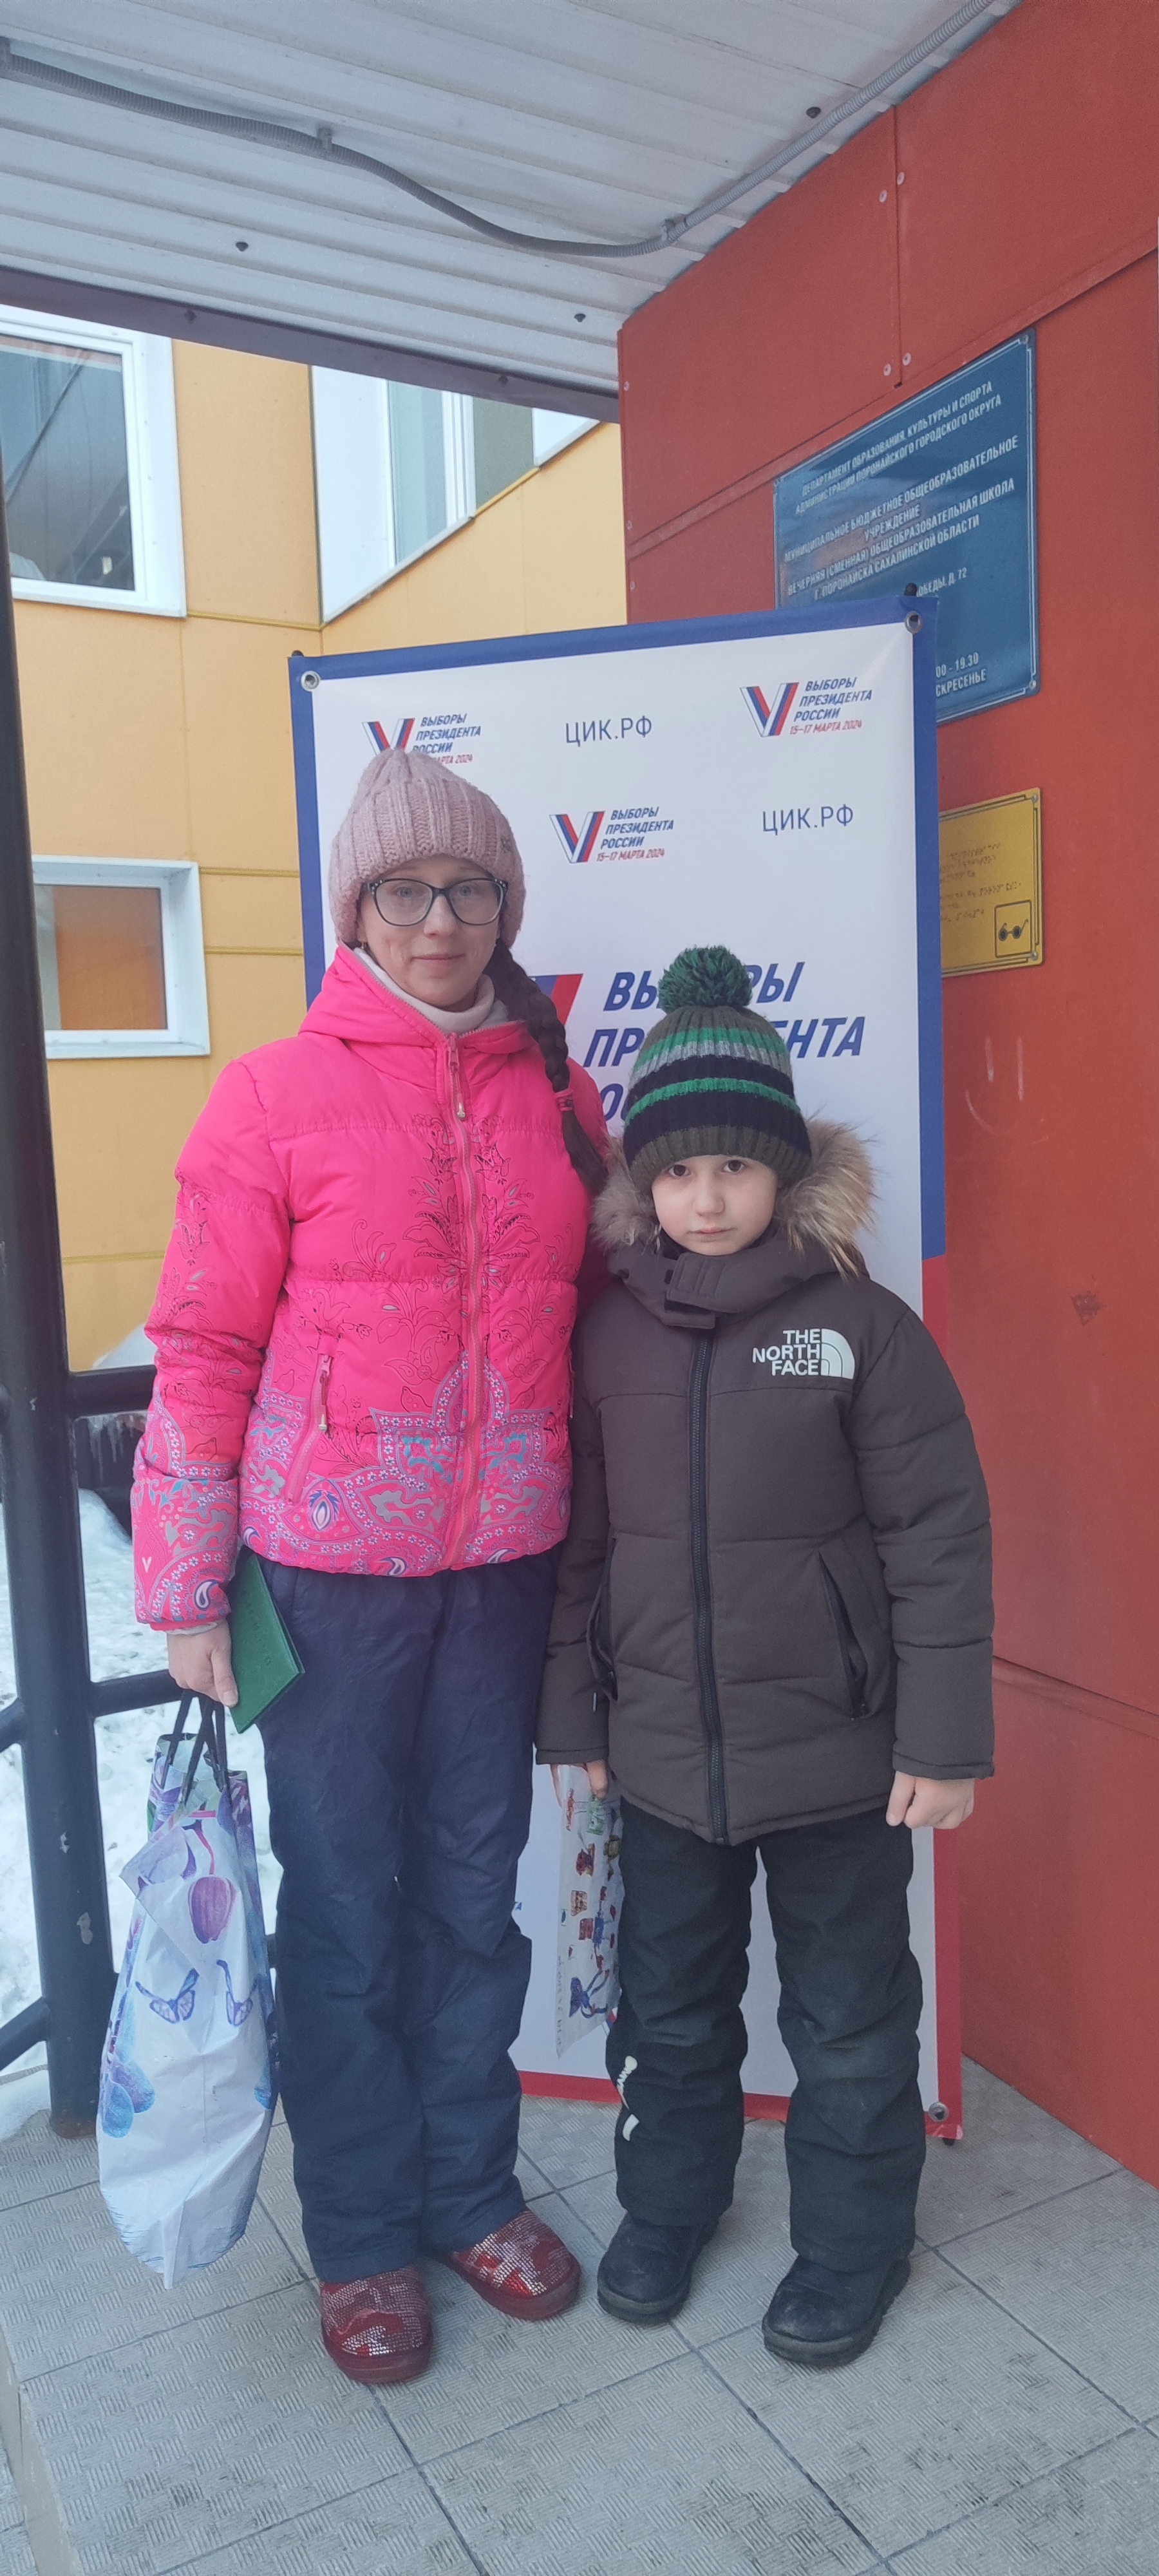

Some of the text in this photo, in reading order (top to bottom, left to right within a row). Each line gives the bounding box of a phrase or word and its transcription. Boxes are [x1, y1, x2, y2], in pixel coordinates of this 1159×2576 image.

[908, 406, 950, 437] КУЛЬТУРЫ
[952, 399, 958, 412] И
[959, 381, 992, 409] СПОРТА
[915, 415, 968, 450] ГОРОДСКОГО
[968, 394, 1001, 421] ОКРУГА
[784, 435, 1018, 563] МУНИЦИПАЛЬНОЕ БЮДЖЕТНОЕ ОБЩЕОБРАЗОВАТЕЛЬНОЕ
[864, 504, 921, 541] УЧРЕЖДЕНИЕ
[788, 477, 1014, 596] ВЕЧЕРНЯЯ (СМЕННАЯ) ОБЩЕОБРАЗОВАТЕЛЬНАЯ ШКОЛА
[874, 533, 936, 573] САХАЛИНСКОЙ
[937, 514, 980, 544] ОБЛАСТИ
[958, 567, 967, 580] 72
[955, 652, 979, 671] 19.30
[804, 677, 857, 692] ВЫБОРЫ
[799, 690, 872, 707] ПРЕЗИДЕНТА
[420, 714, 467, 727] ВЫБОРЫ
[793, 708, 840, 722] РОССИИ
[416, 726, 481, 741] ПРЕЗИДЕНТА
[565, 715, 652, 747] ЦИК.РФ
[813, 722, 840, 734] МАРТА
[842, 719, 862, 731] 2024
[455, 754, 473, 764] 2024
[610, 806, 659, 820] ВЫБОРЫ
[762, 804, 853, 836] ЦИК.РФ
[605, 820, 674, 835] ПРЕЗИДЕНТА
[600, 836, 645, 849] РОССИИ
[618, 849, 645, 860] МАРТА
[646, 848, 665, 858] 2024
[782, 1328, 820, 1344] THE
[752, 1343, 820, 1363] NORTH
[771, 1359, 819, 1376] FACE
